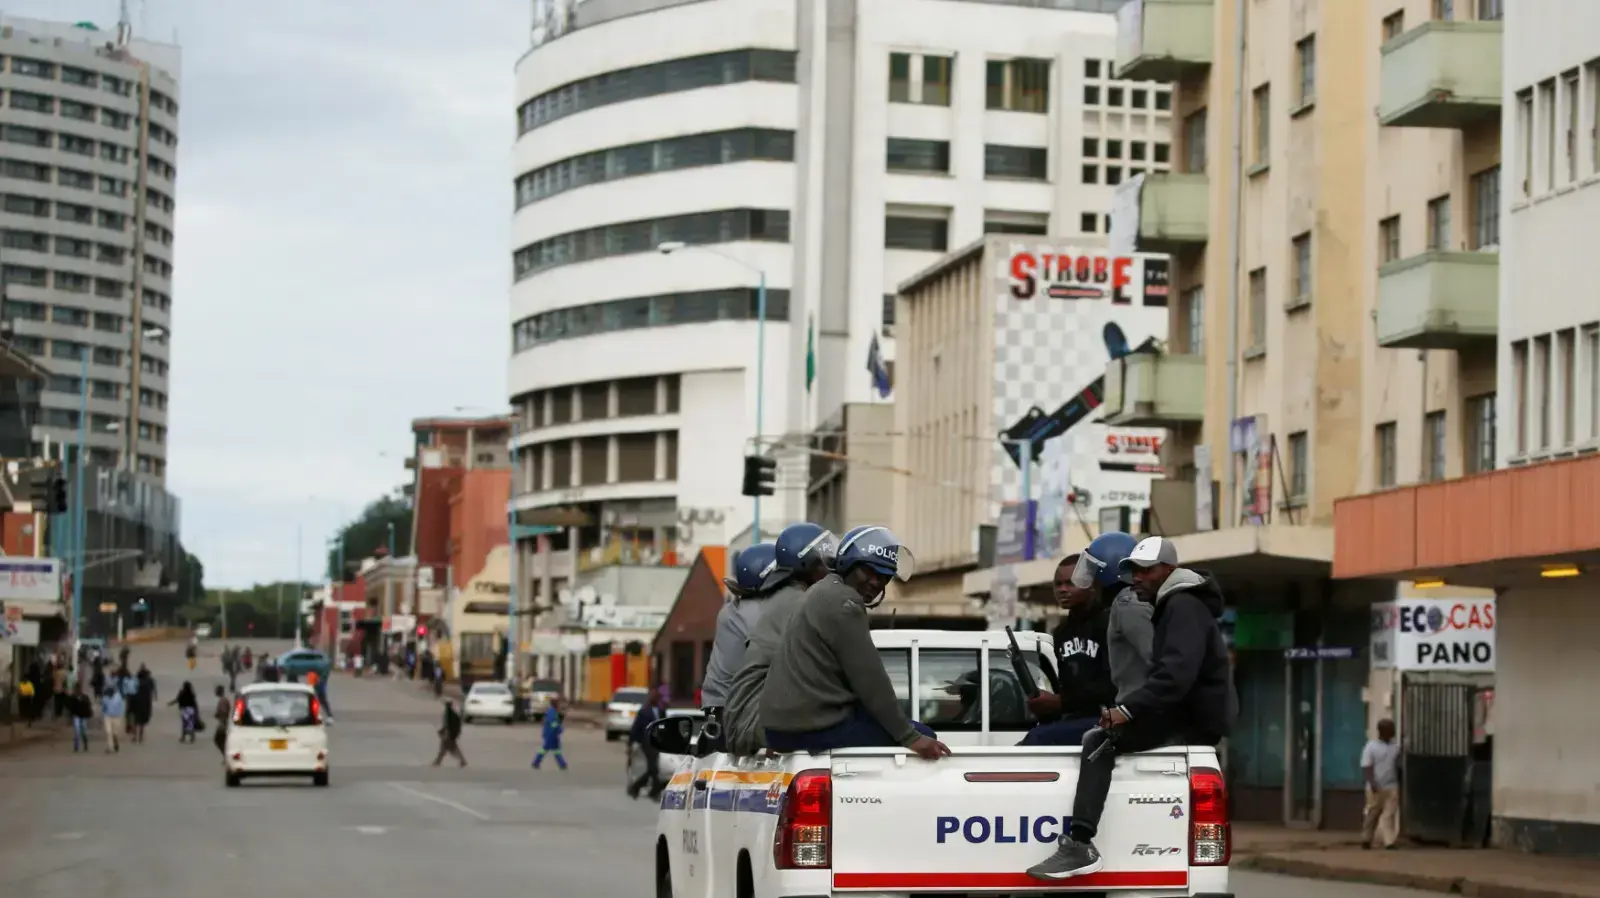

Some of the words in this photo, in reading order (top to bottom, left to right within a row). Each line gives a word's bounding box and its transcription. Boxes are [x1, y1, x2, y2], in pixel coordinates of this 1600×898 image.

[1010, 253, 1133, 305] STROBE
[1416, 641, 1492, 664] PANO
[1128, 793, 1184, 804] HILUX
